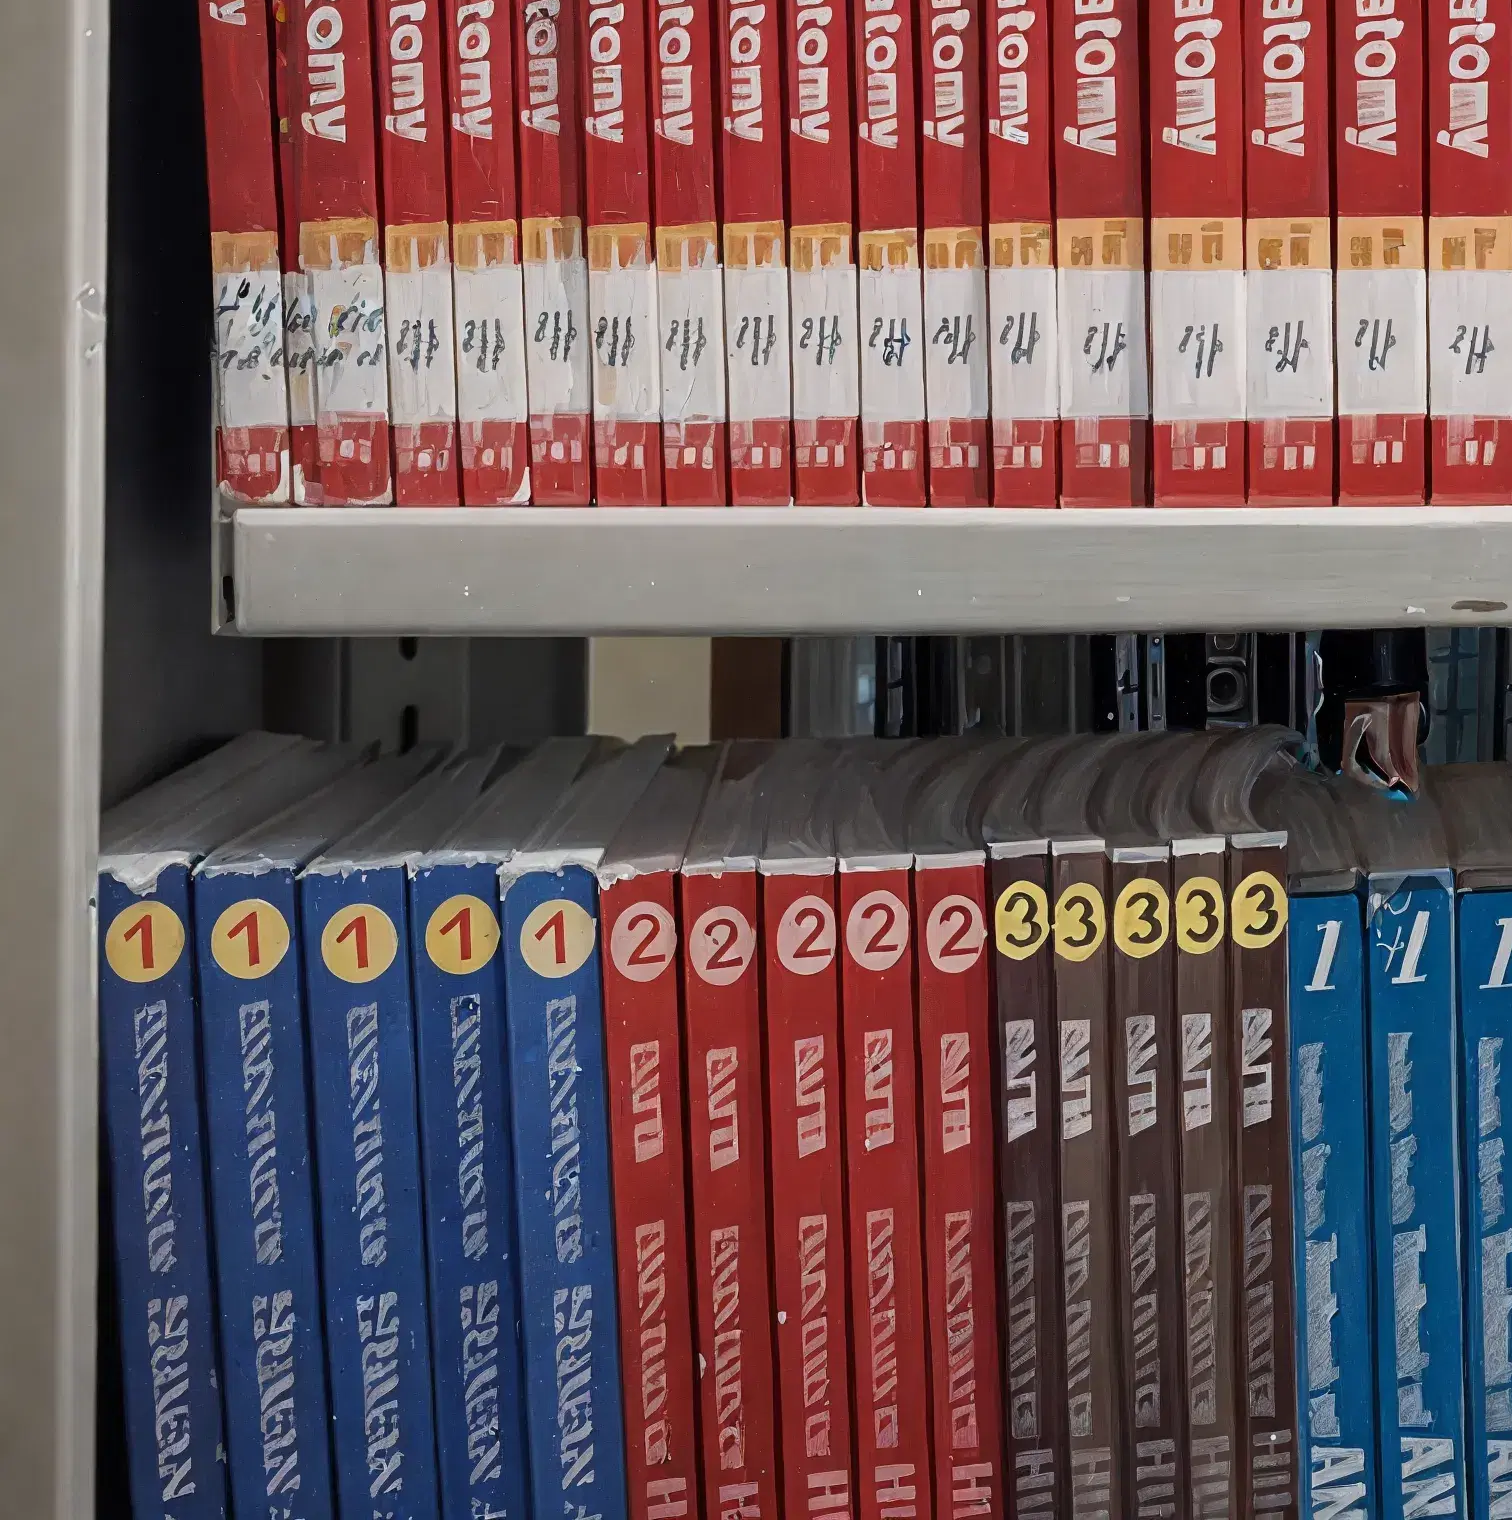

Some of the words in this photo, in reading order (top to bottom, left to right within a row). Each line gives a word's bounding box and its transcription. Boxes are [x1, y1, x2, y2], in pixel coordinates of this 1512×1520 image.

[440, 908, 471, 960] 1
[793, 908, 831, 958] 2
[861, 903, 898, 953] 2
[939, 905, 979, 958] 2
[1004, 892, 1042, 947] 3
[1063, 896, 1097, 947] 3
[1127, 893, 1162, 943] 3
[1187, 890, 1218, 942] 3
[1245, 884, 1278, 935] 3
[125, 915, 153, 969] 1
[228, 911, 259, 967] 1
[337, 916, 368, 968] 1
[535, 910, 566, 963] 1
[627, 914, 666, 966] 2
[704, 919, 743, 970] 2
[1305, 920, 1342, 991] 1
